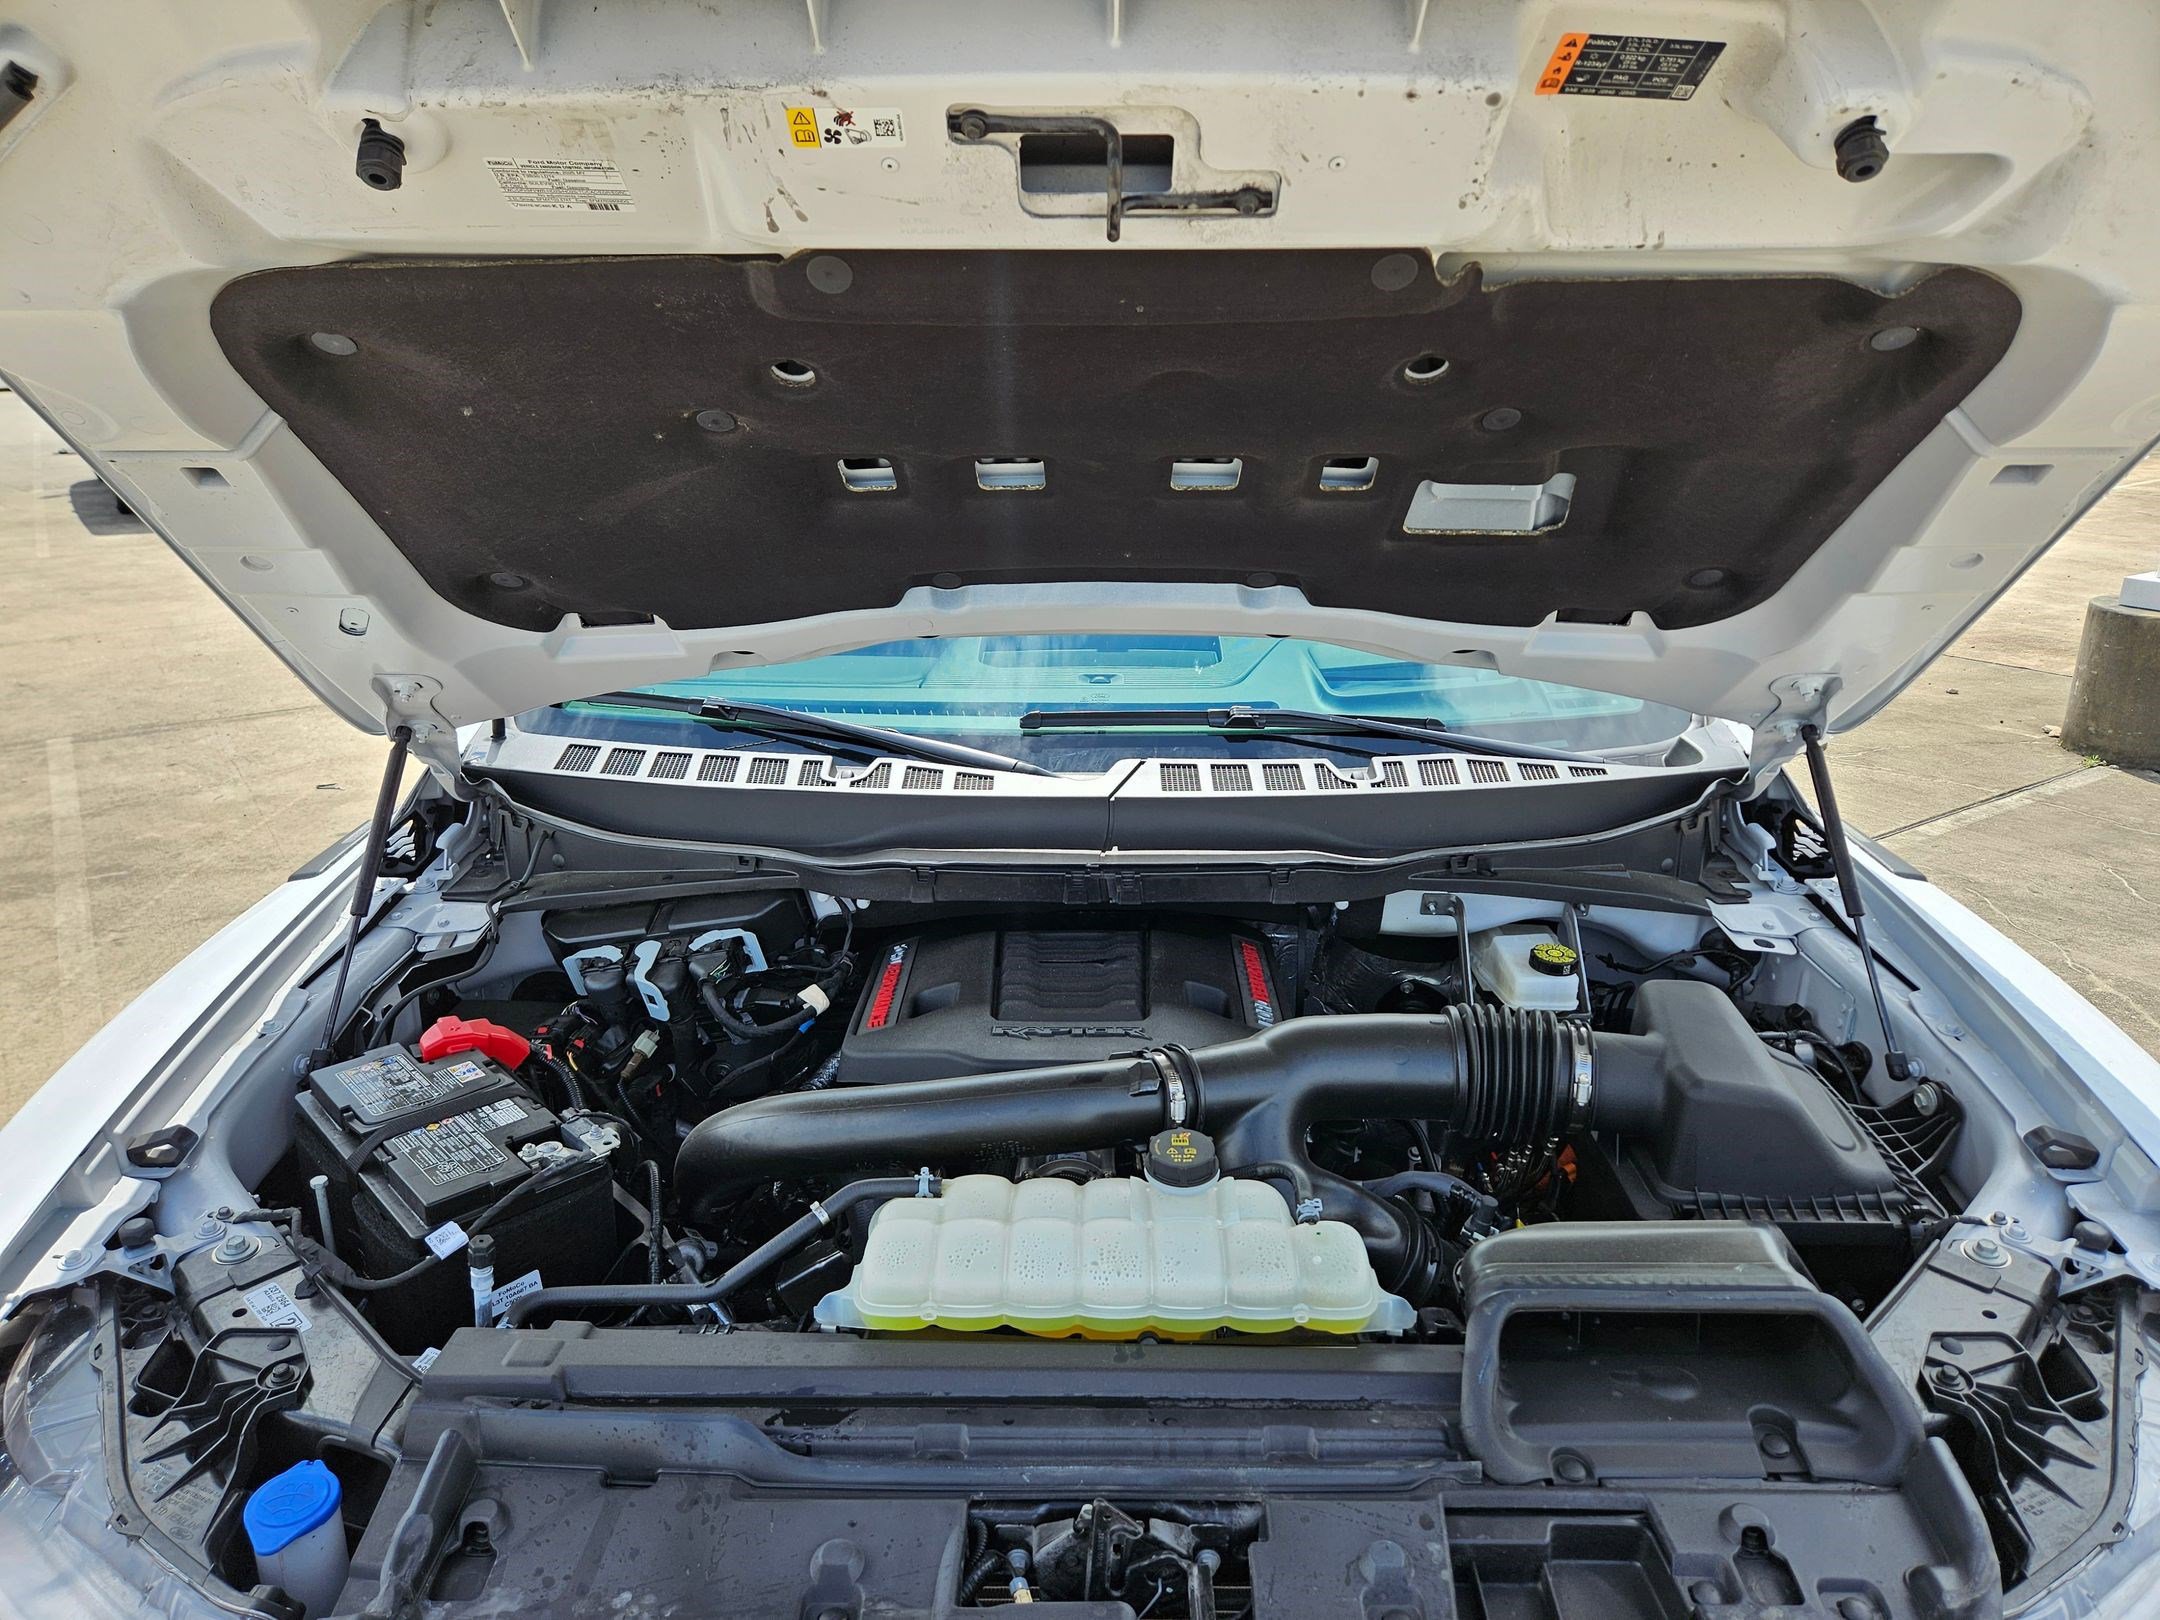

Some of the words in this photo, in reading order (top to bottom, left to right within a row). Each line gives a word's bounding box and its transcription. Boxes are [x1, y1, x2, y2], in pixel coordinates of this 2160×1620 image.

[1586, 38, 1618, 46] FoMoCo
[1575, 60, 1607, 68] R-1234yf
[991, 1026, 1153, 1041] RAPTOR
[497, 1280, 525, 1296] FoMoCo
